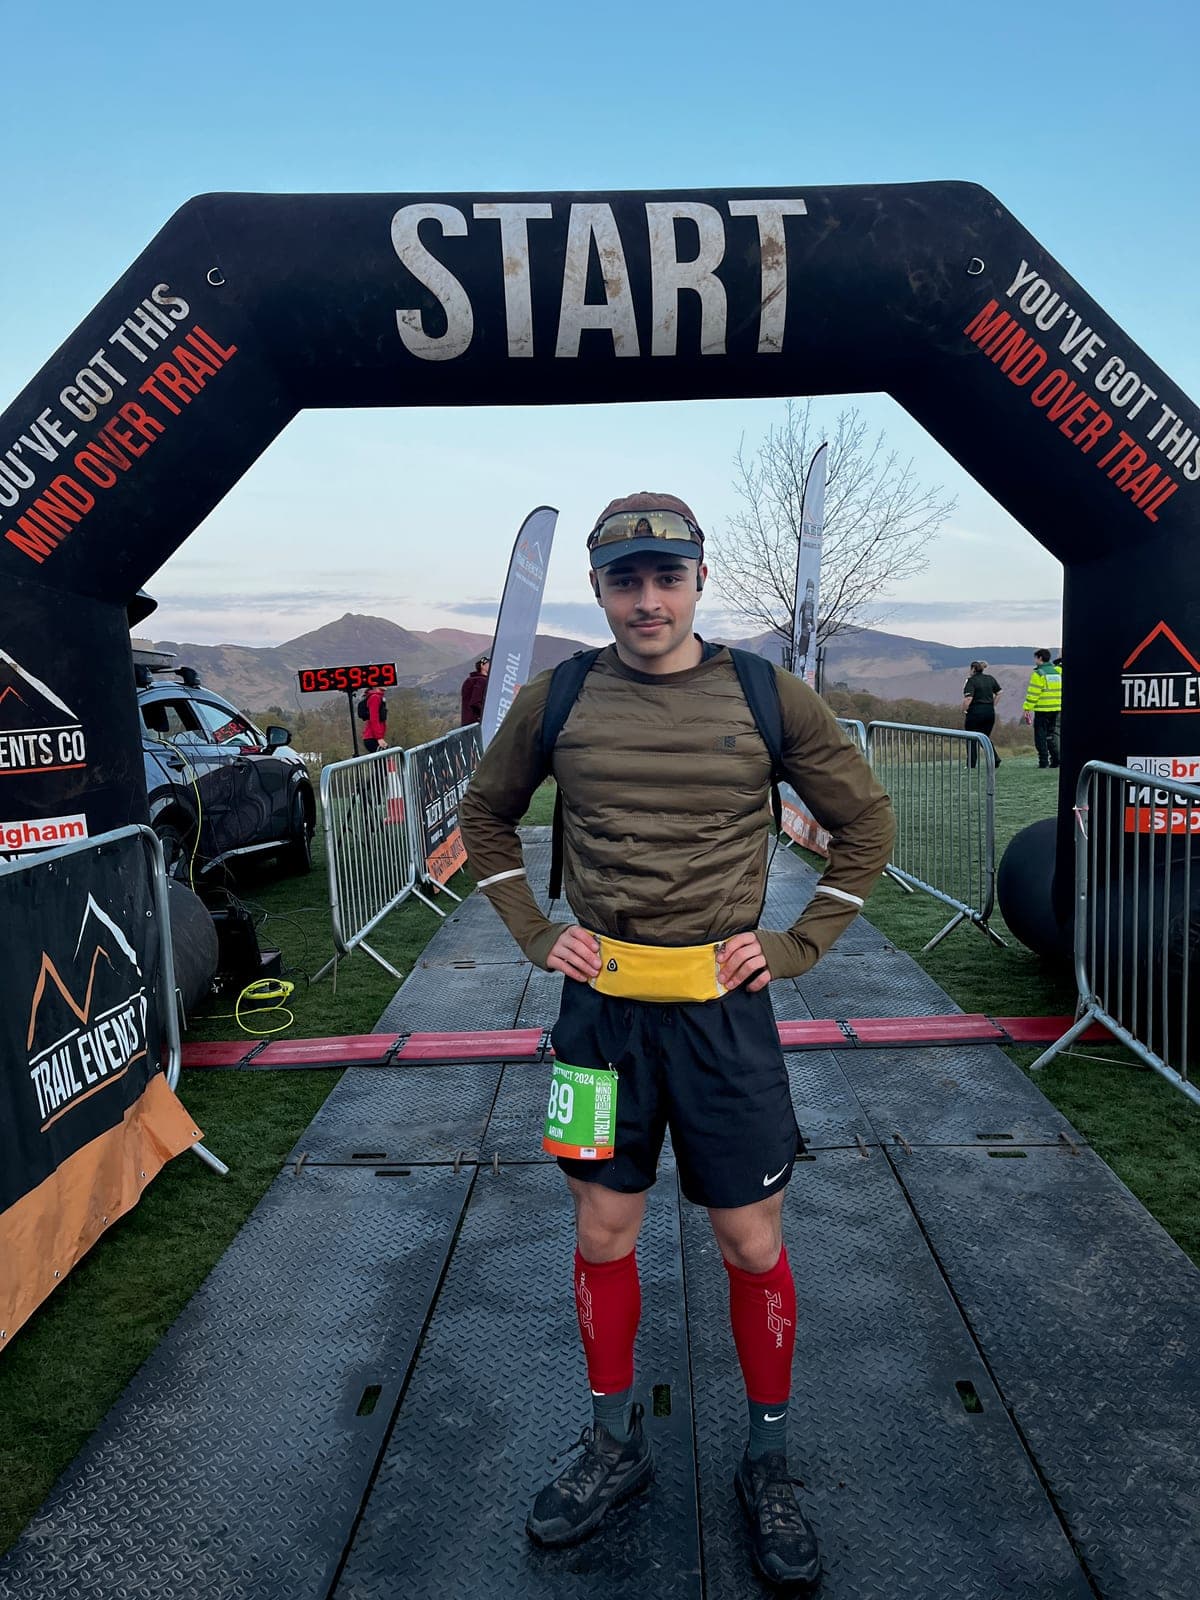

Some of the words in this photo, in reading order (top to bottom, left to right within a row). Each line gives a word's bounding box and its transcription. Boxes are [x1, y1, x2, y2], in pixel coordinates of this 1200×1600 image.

[390, 198, 808, 361] START
[1005, 259, 1107, 373] YOU'VE
[1094, 355, 1158, 421] GOT
[1146, 403, 1200, 480] THIS
[0, 407, 78, 520] OU'VE
[59, 348, 127, 422] GOT
[108, 283, 190, 363] THIS
[963, 298, 1048, 386] MIND
[1030, 368, 1114, 454] OVER
[1096, 430, 1179, 523] TRAIL
[4, 474, 96, 564] MIND
[73, 401, 166, 489] OVER
[138, 325, 238, 416] TRAIL
[302, 664, 396, 692] 05:59:29
[501, 652, 521, 695] TRAIL
[1121, 678, 1180, 707] TRAIL
[1185, 677, 1200, 706] E
[0, 733, 54, 768] ENTS
[58, 730, 86, 763] CO
[30, 1045, 83, 1119] TRAIL
[548, 1079, 574, 1124] 89
[575, 1073, 594, 1086] 2024
